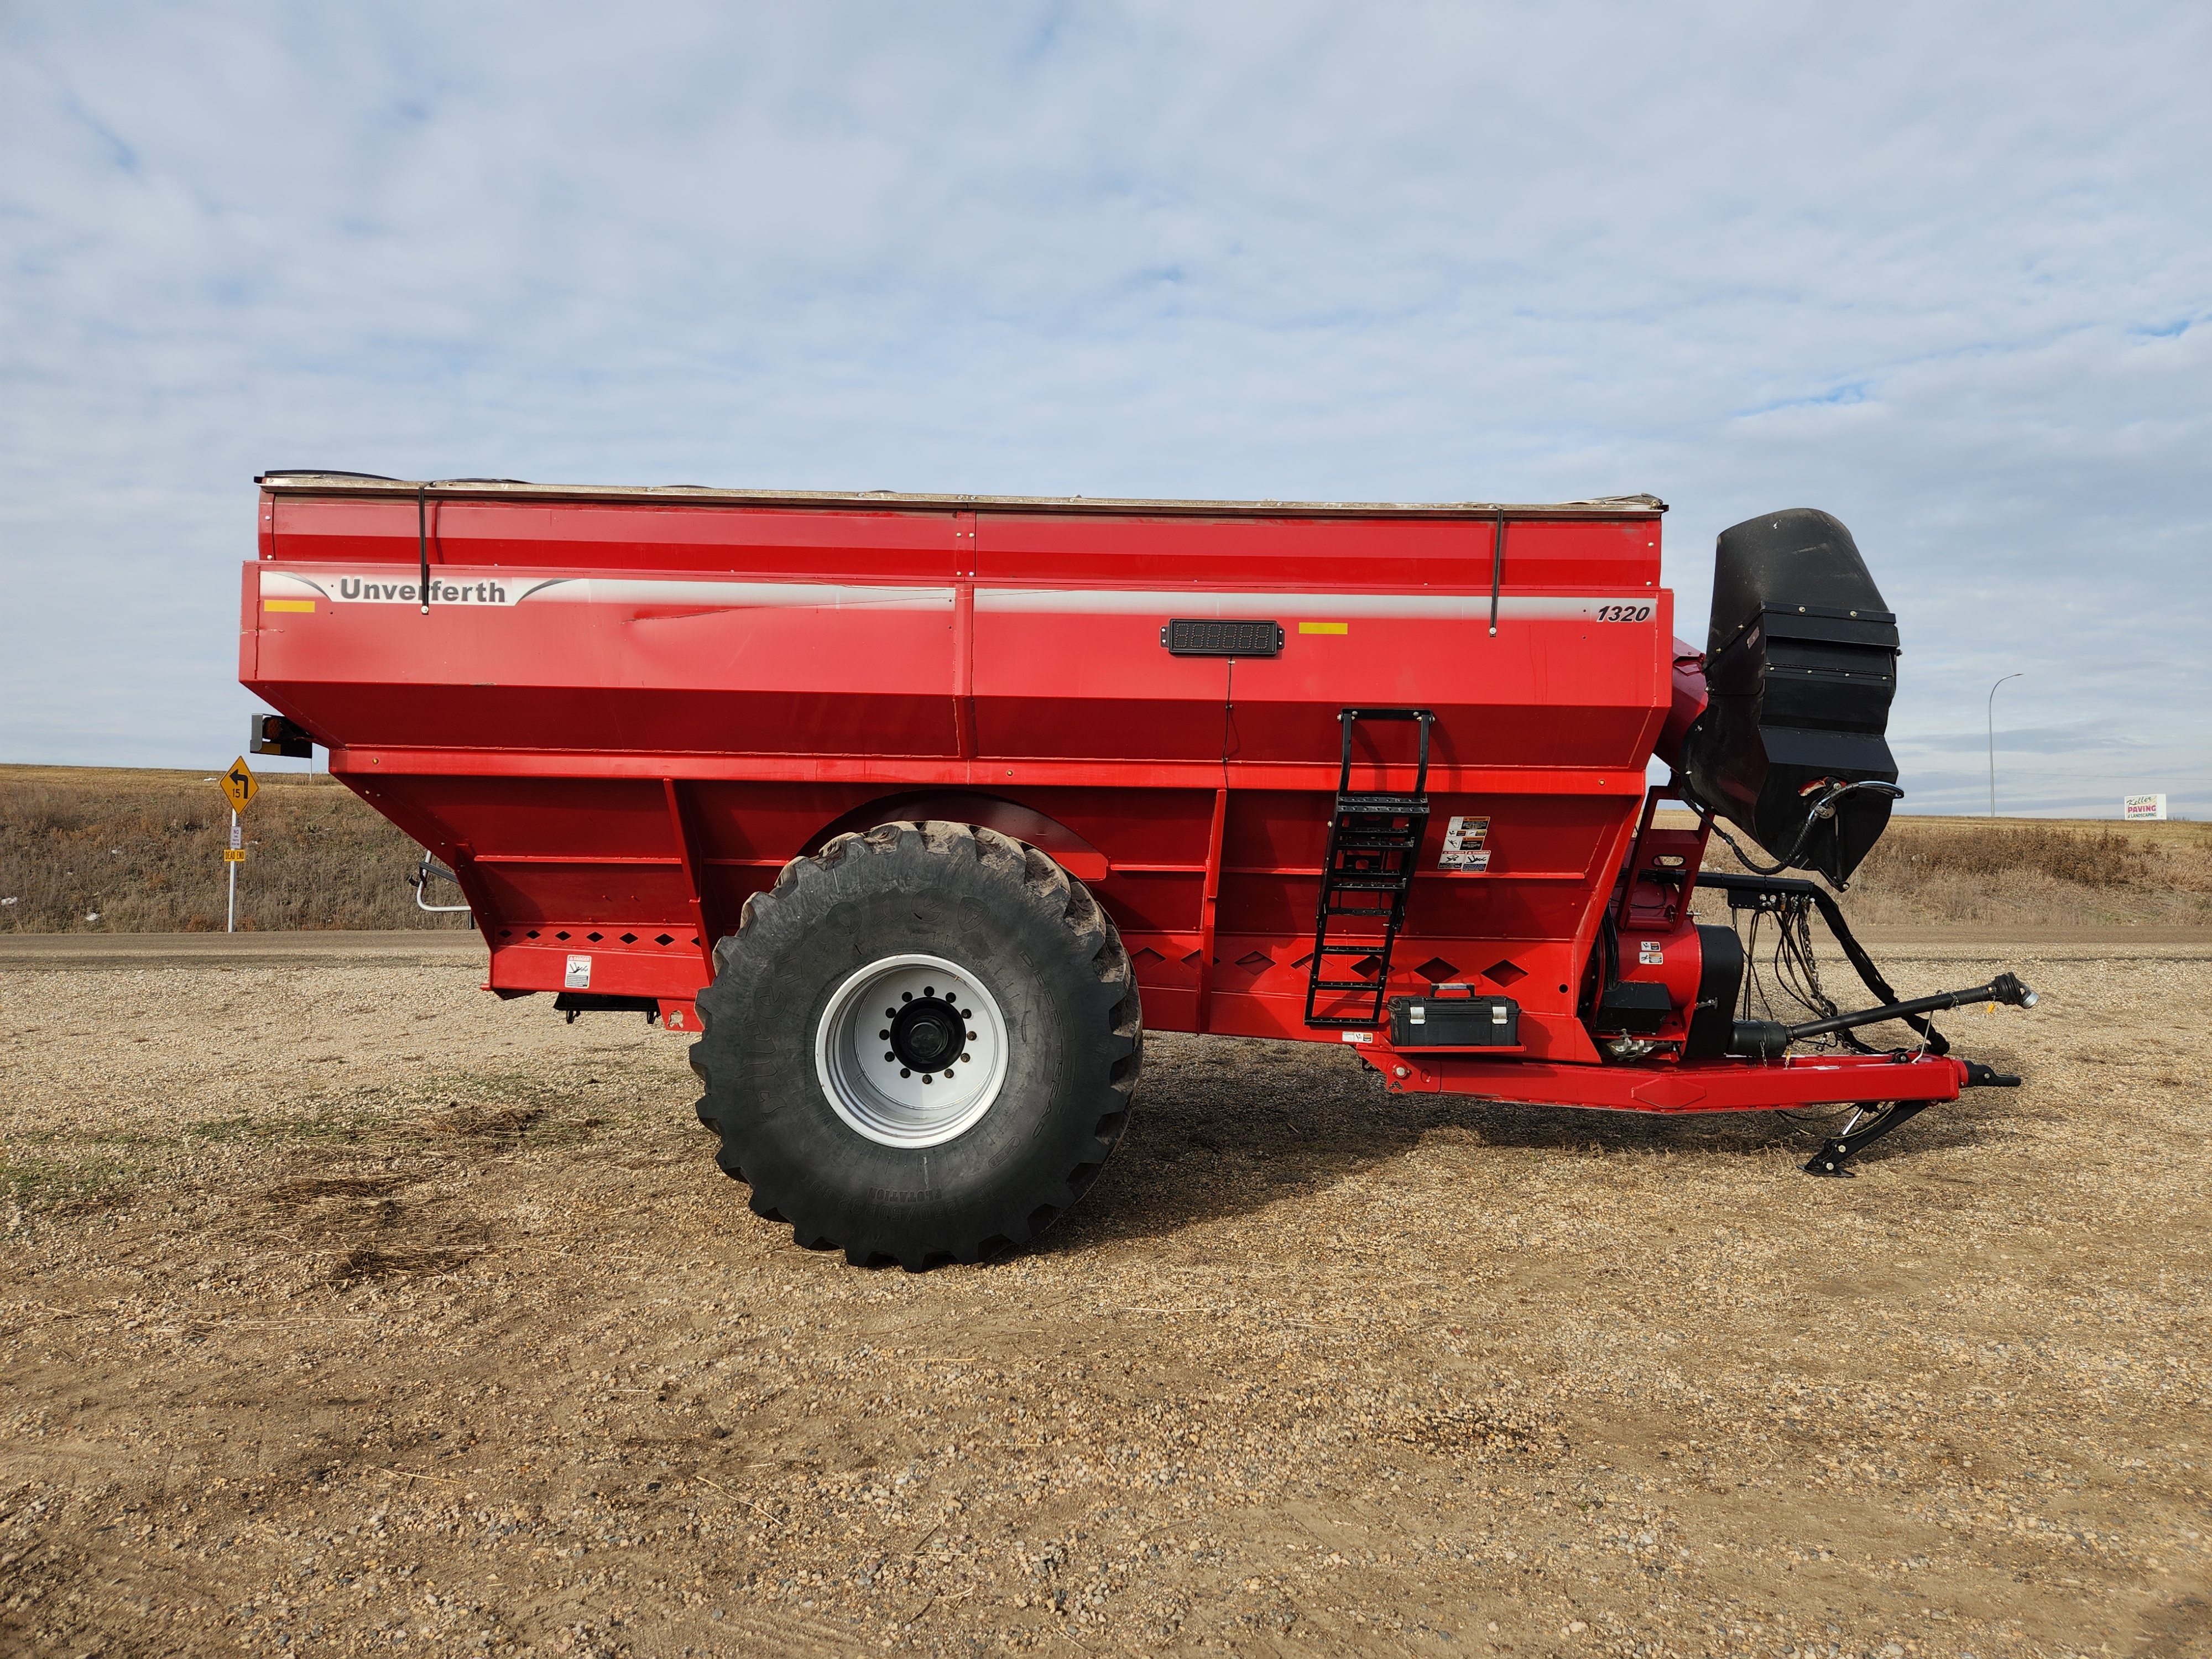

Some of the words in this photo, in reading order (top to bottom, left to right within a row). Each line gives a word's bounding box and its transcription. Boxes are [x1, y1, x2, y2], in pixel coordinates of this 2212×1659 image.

[1597, 606, 1651, 622] 1320
[232, 789, 241, 798] 15
[2126, 796, 2152, 806] Keller
[226, 851, 235, 860] DEAD
[1019, 951, 1061, 1026] DEEP
[742, 888, 945, 1122] Firestone
[1032, 1038, 1063, 1139] TREAD
[867, 1187, 942, 1203] FLOTATION
[838, 1193, 967, 1222] 1250/50R32
